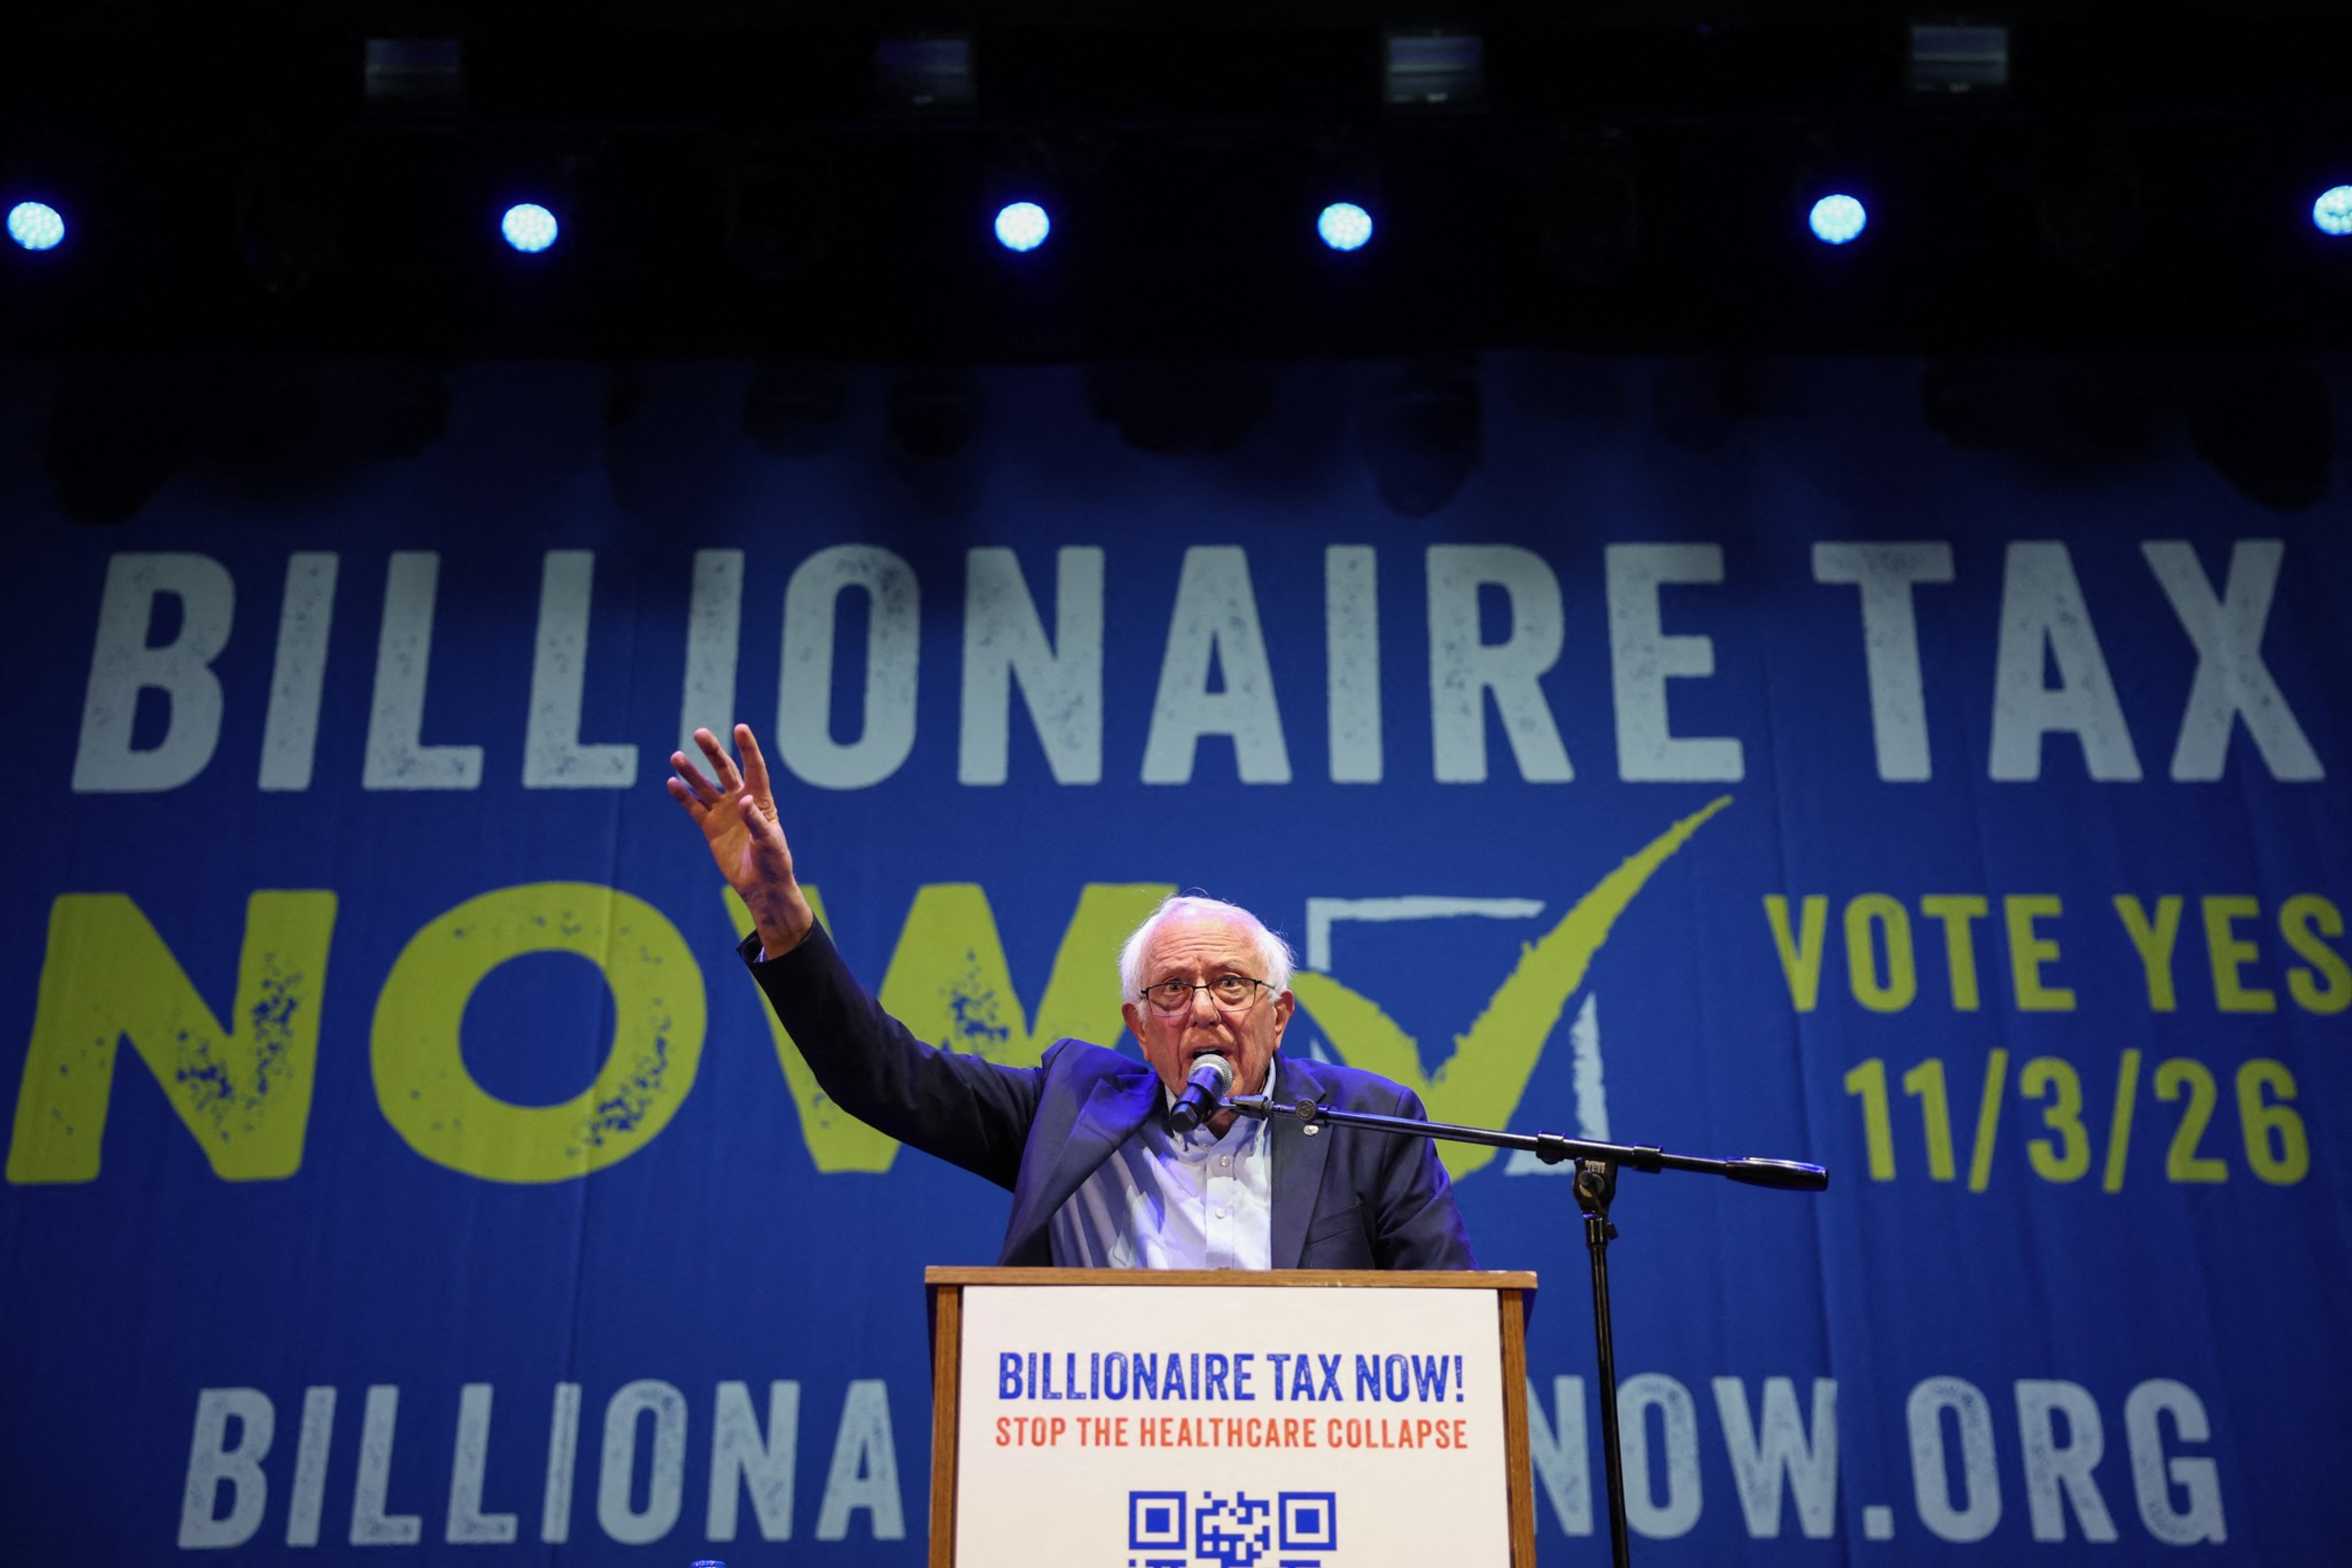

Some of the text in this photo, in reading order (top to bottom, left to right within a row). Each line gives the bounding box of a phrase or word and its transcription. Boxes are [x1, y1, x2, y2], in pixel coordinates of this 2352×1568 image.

[71, 540, 2326, 793] BILLIONAIRE TAX
[1762, 892, 2352, 1016] VOTE YES
[6, 880, 1180, 1185] NOW
[1843, 1047, 2310, 1194] 11/3/26
[995, 1416, 1468, 1450] STOP THE HEALTHCARE COLLAPSE
[999, 1352, 1464, 1403] BILLIONAIRE TAX NOW!
